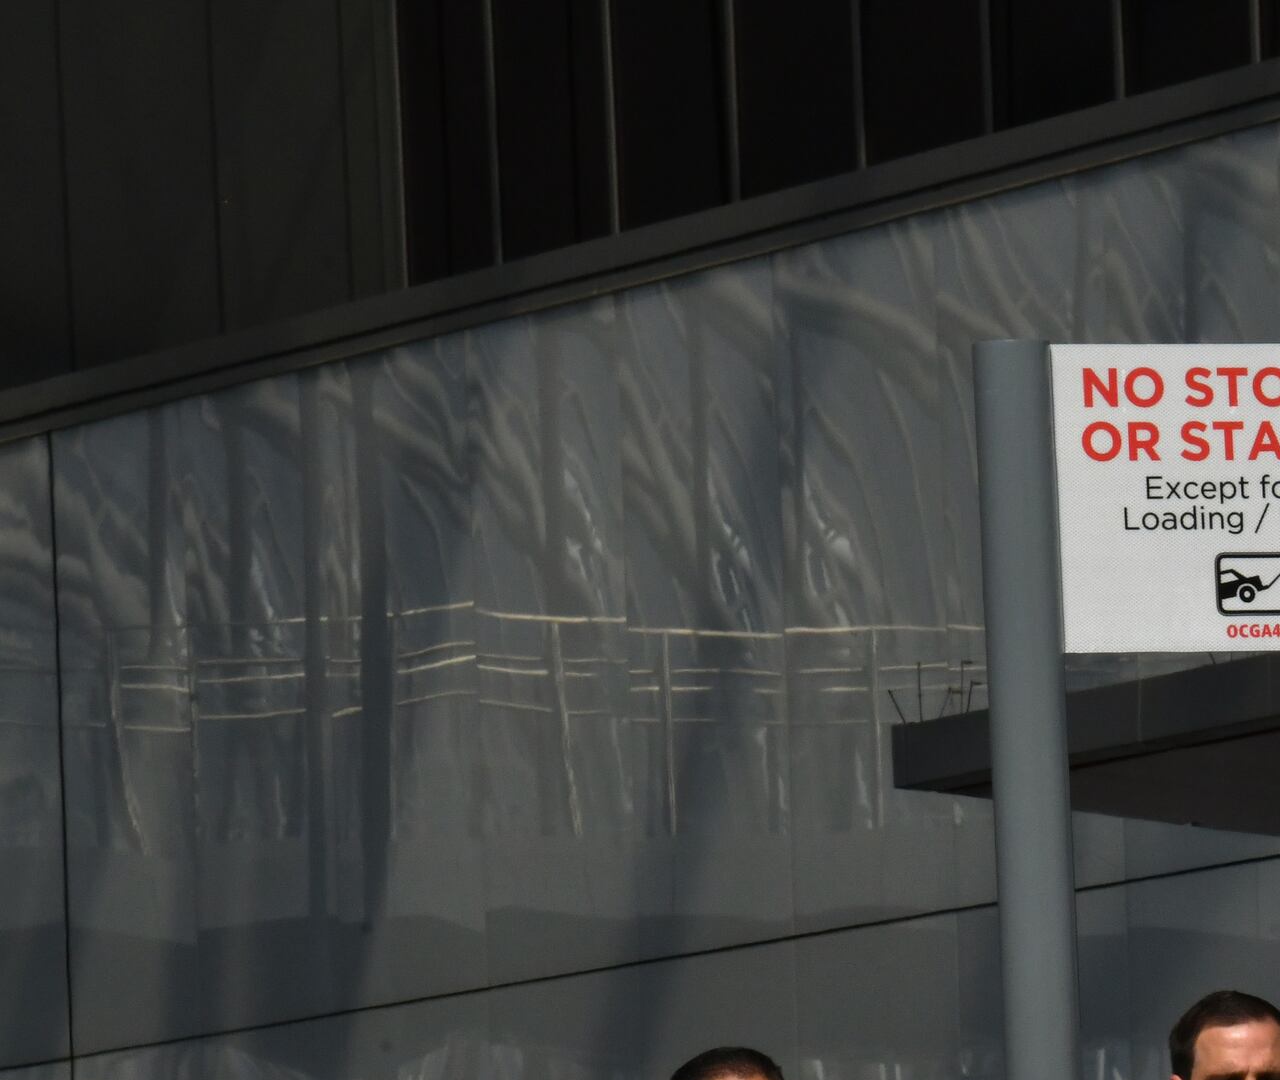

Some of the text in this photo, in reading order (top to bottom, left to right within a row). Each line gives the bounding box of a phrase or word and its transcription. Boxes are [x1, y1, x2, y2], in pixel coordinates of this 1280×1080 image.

[1083, 368, 1164, 407] NO
[1082, 422, 1160, 461] OR
[1145, 475, 1250, 504] Except
[1124, 506, 1245, 535] Loading
[1254, 503, 1269, 534] /
